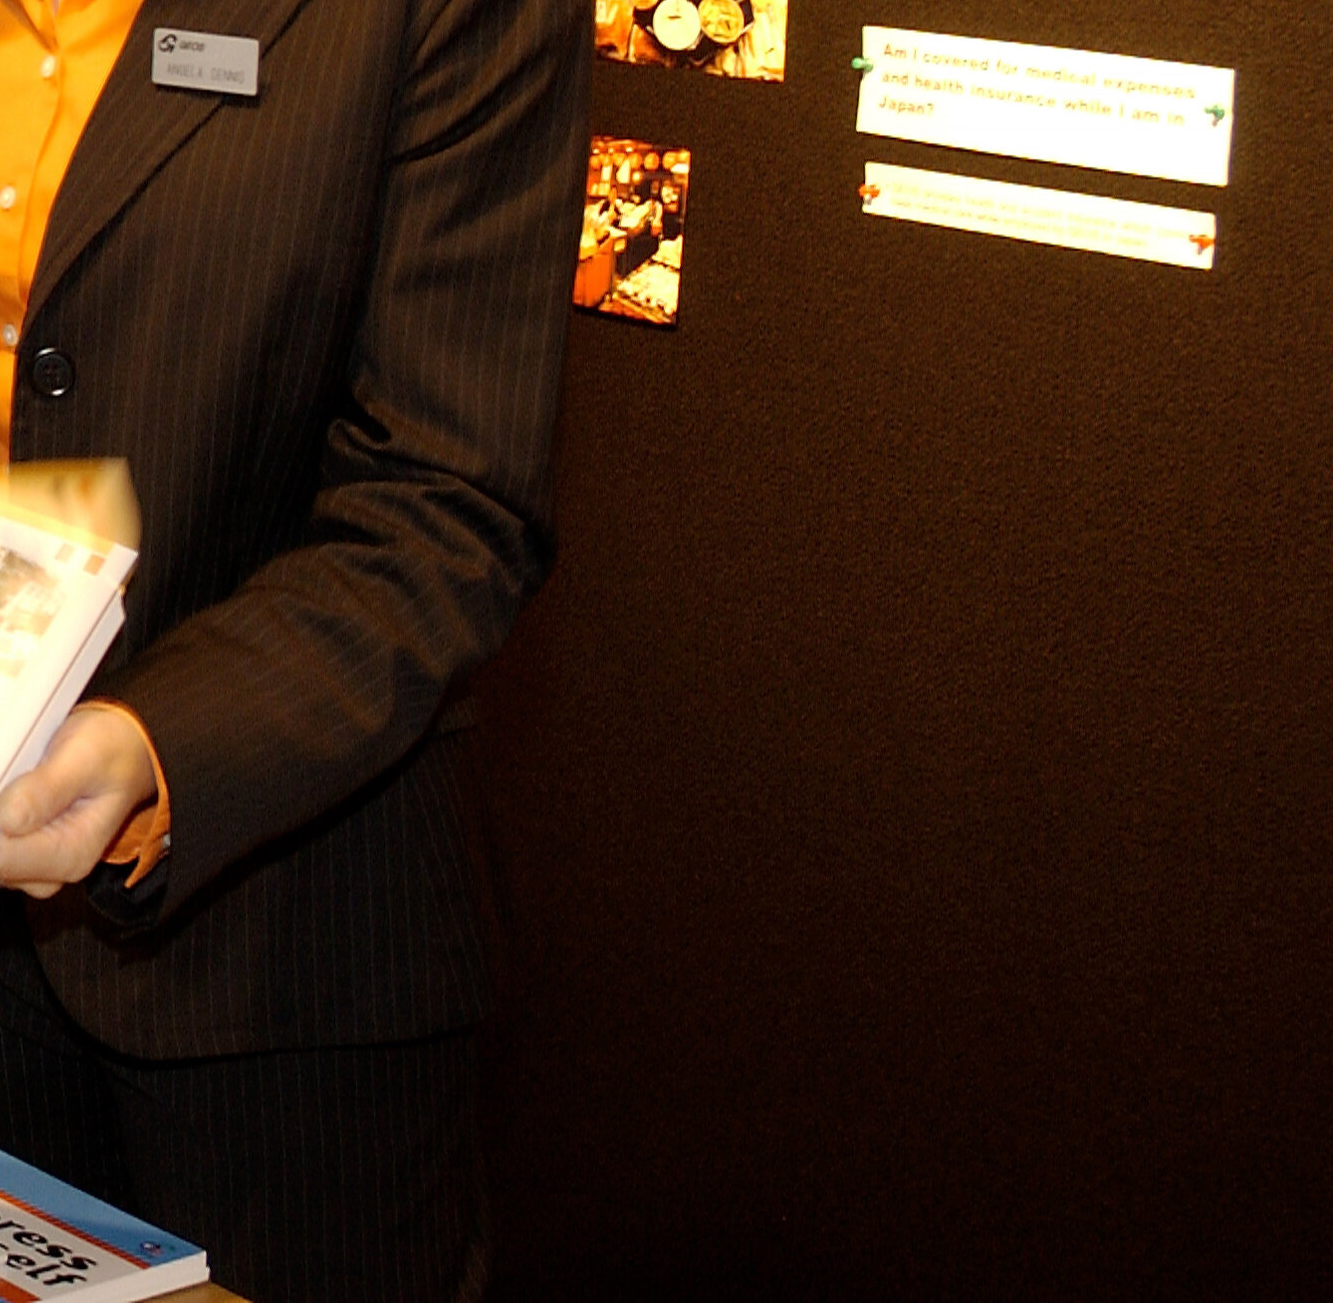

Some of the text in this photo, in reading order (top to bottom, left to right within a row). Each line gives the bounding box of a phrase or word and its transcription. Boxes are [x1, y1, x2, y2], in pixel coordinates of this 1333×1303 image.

[880, 70, 910, 86] and
[914, 73, 965, 96] health
[969, 82, 1057, 109] insurance
[1062, 96, 1113, 117] while
[1131, 107, 1160, 123] am
[1167, 109, 1185, 127] in
[881, 42, 908, 60] Am
[922, 49, 990, 72] covered
[995, 58, 1019, 77] for
[1025, 63, 1098, 88] medical
[1102, 75, 1196, 100] expenses
[877, 94, 935, 117] Japan?
